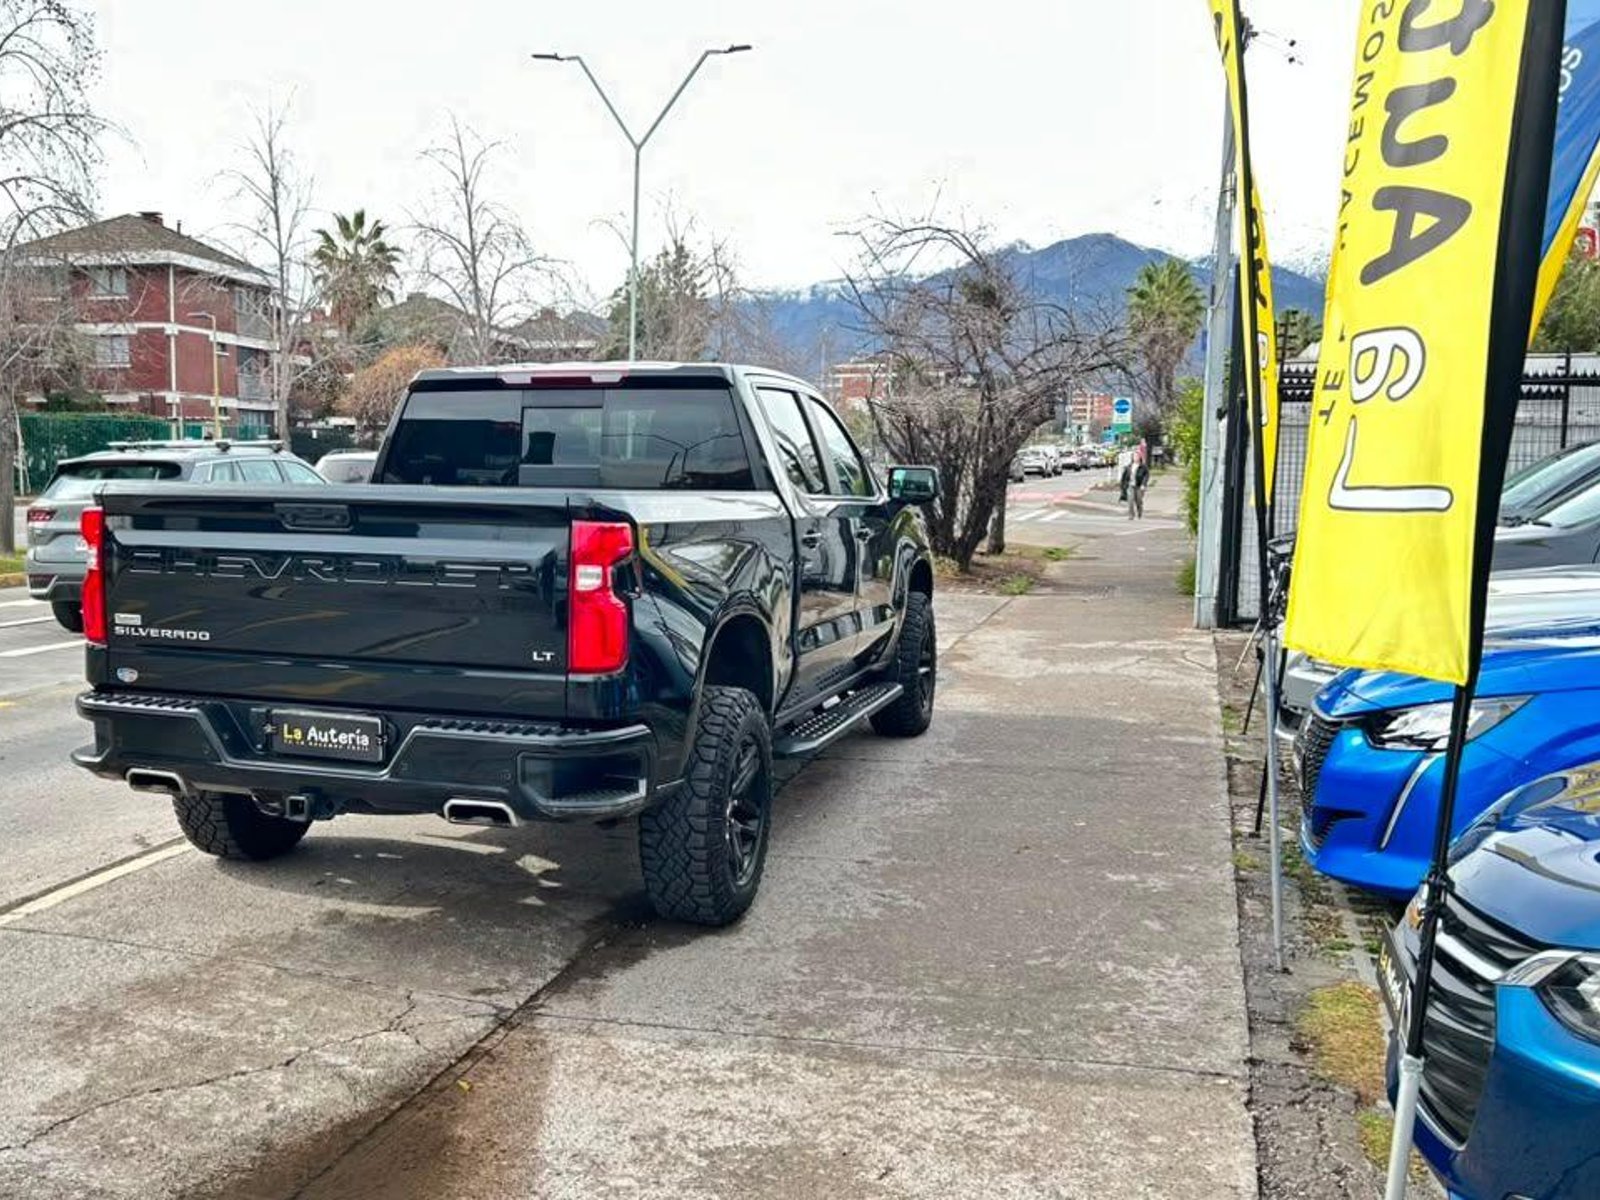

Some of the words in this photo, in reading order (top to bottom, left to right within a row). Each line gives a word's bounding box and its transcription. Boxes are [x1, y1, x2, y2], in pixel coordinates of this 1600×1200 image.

[128, 551, 530, 590] CHEVROLET
[113, 625, 210, 641] SILVERADO
[532, 650, 555, 662] LT
[282, 722, 303, 740] La
[306, 725, 370, 746] Autería
